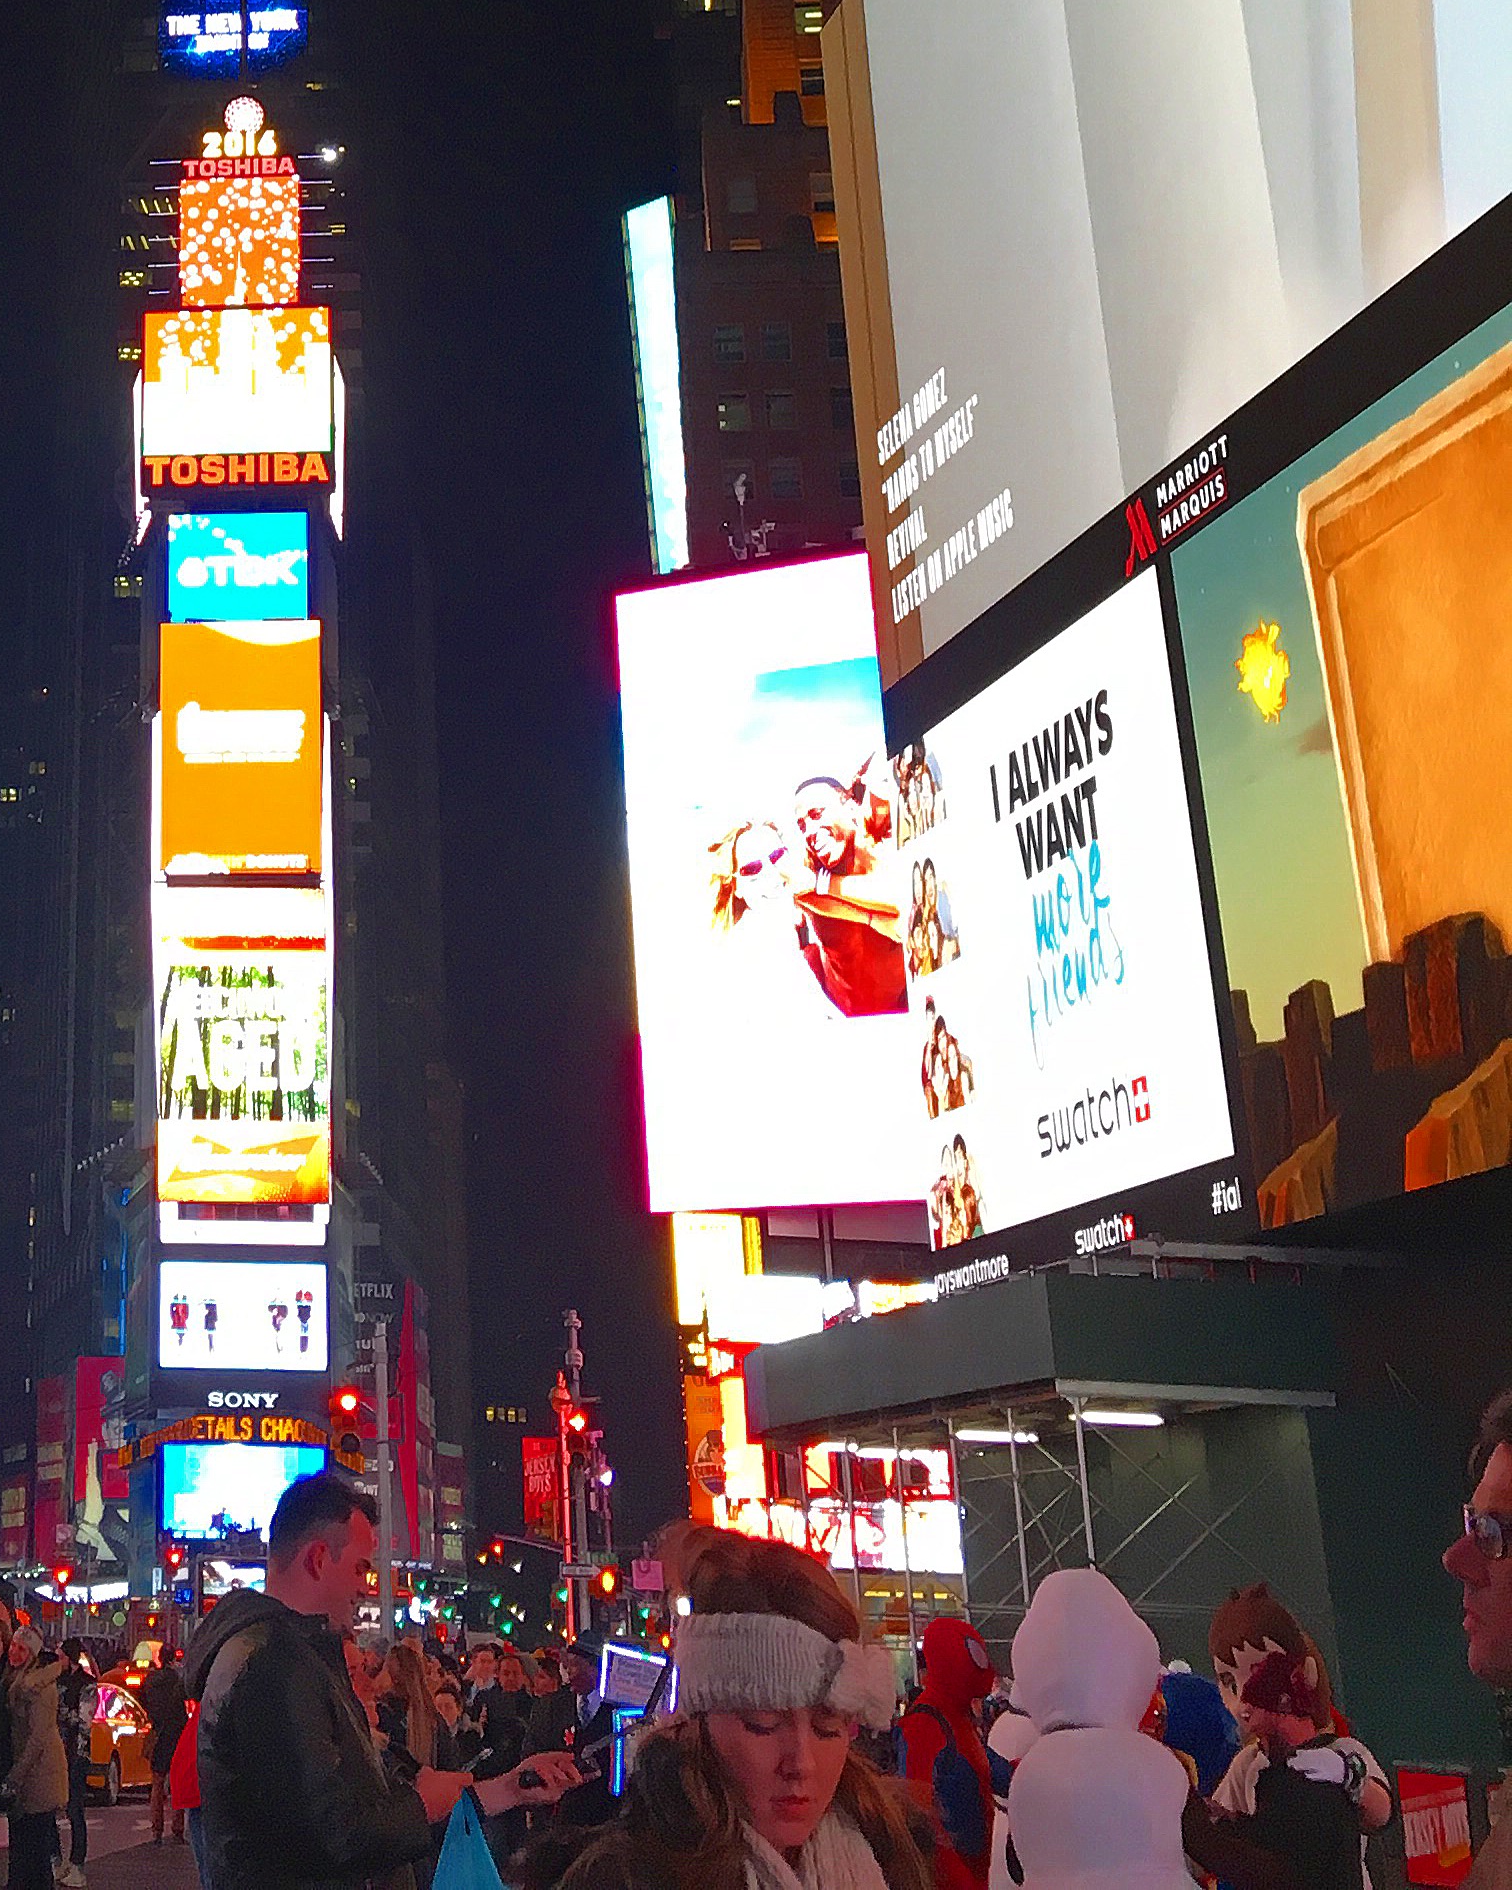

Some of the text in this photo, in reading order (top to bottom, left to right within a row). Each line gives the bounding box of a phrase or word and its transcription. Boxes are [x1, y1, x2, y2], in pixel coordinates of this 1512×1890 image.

[183, 156, 295, 177] TOSHIBA
[202, 129, 276, 158] 2016
[877, 366, 948, 466] SELENA GOMEZ
[144, 451, 329, 488] TOSHIBA
[919, 438, 934, 482] TO
[1156, 434, 1228, 508] MARRIOTT
[886, 505, 928, 571] REVIVAL
[1160, 474, 1225, 539] MARQUIS
[891, 488, 1014, 624] LISTEN ON APPLE MUSIC
[989, 688, 1114, 824] I ALWAYS
[1015, 775, 1099, 880] WANT
[1037, 1076, 1133, 1158] swatch
[1074, 1213, 1126, 1256] swatch
[353, 1282, 394, 1300] ETFLIX
[207, 1391, 279, 1409] SONY
